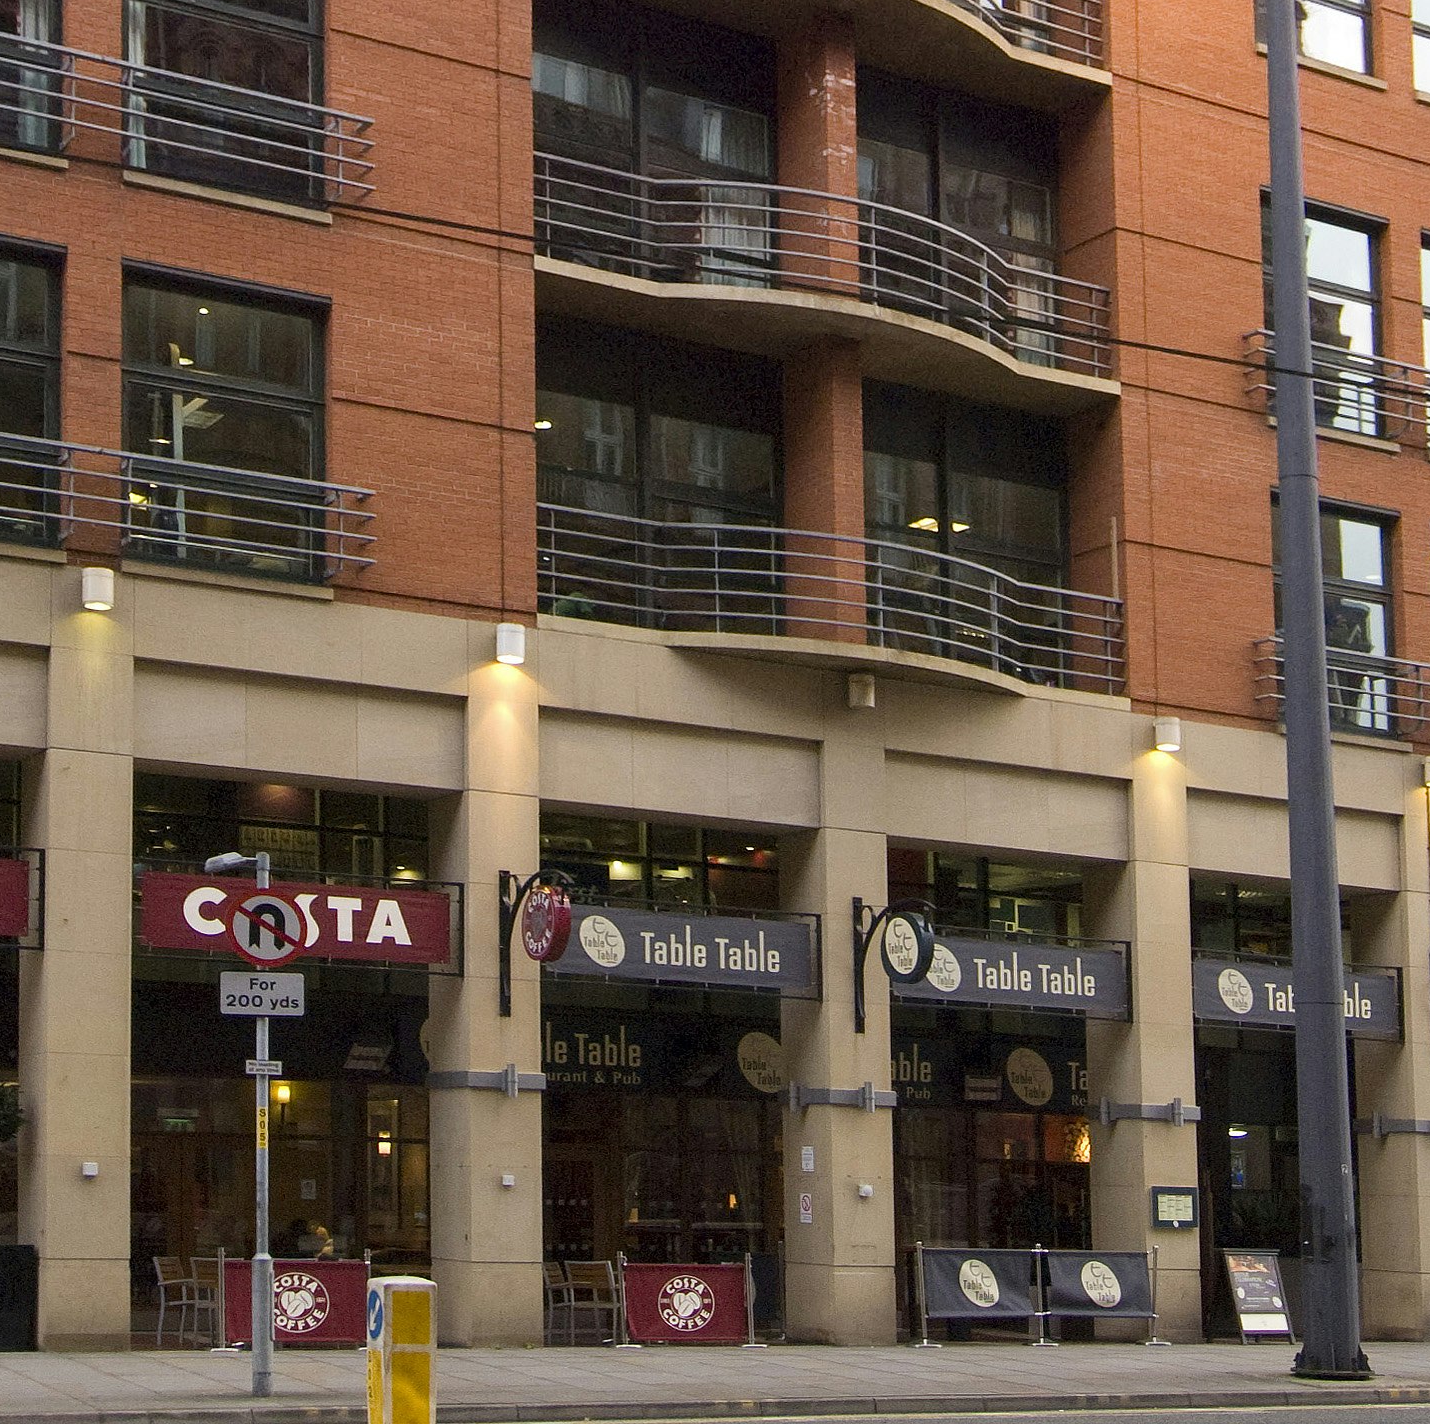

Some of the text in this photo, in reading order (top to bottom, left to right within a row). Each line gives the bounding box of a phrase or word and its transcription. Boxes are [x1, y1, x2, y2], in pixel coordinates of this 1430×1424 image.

[527, 892, 550, 913] COSTA
[182, 886, 413, 949] CSTA
[525, 928, 552, 953] COFFEE
[584, 935, 605, 948] Table
[640, 924, 781, 973] Table Table
[887, 939, 904, 955] Table
[597, 947, 618, 961] Table
[897, 950, 913, 968] Table
[936, 973, 955, 986] Table
[973, 951, 1096, 997] Table Table
[249, 978, 277, 991] For
[226, 994, 300, 1011] 200 yds
[1343, 981, 1372, 1019] ble
[574, 1025, 642, 1068] Table
[742, 1058, 767, 1071] Table
[594, 1071, 605, 1084] &
[613, 1072, 642, 1085] Pub
[906, 1087, 931, 1100] Pub
[274, 1275, 318, 1293] COSTA
[666, 1278, 705, 1295] COSTA
[963, 1278, 982, 1290] Table
[1085, 1280, 1104, 1290] Table
[975, 1290, 995, 1302] Table
[1097, 1291, 1116, 1302] Table
[274, 1308, 325, 1330] COFFEE
[663, 1308, 710, 1329] COFFEE
